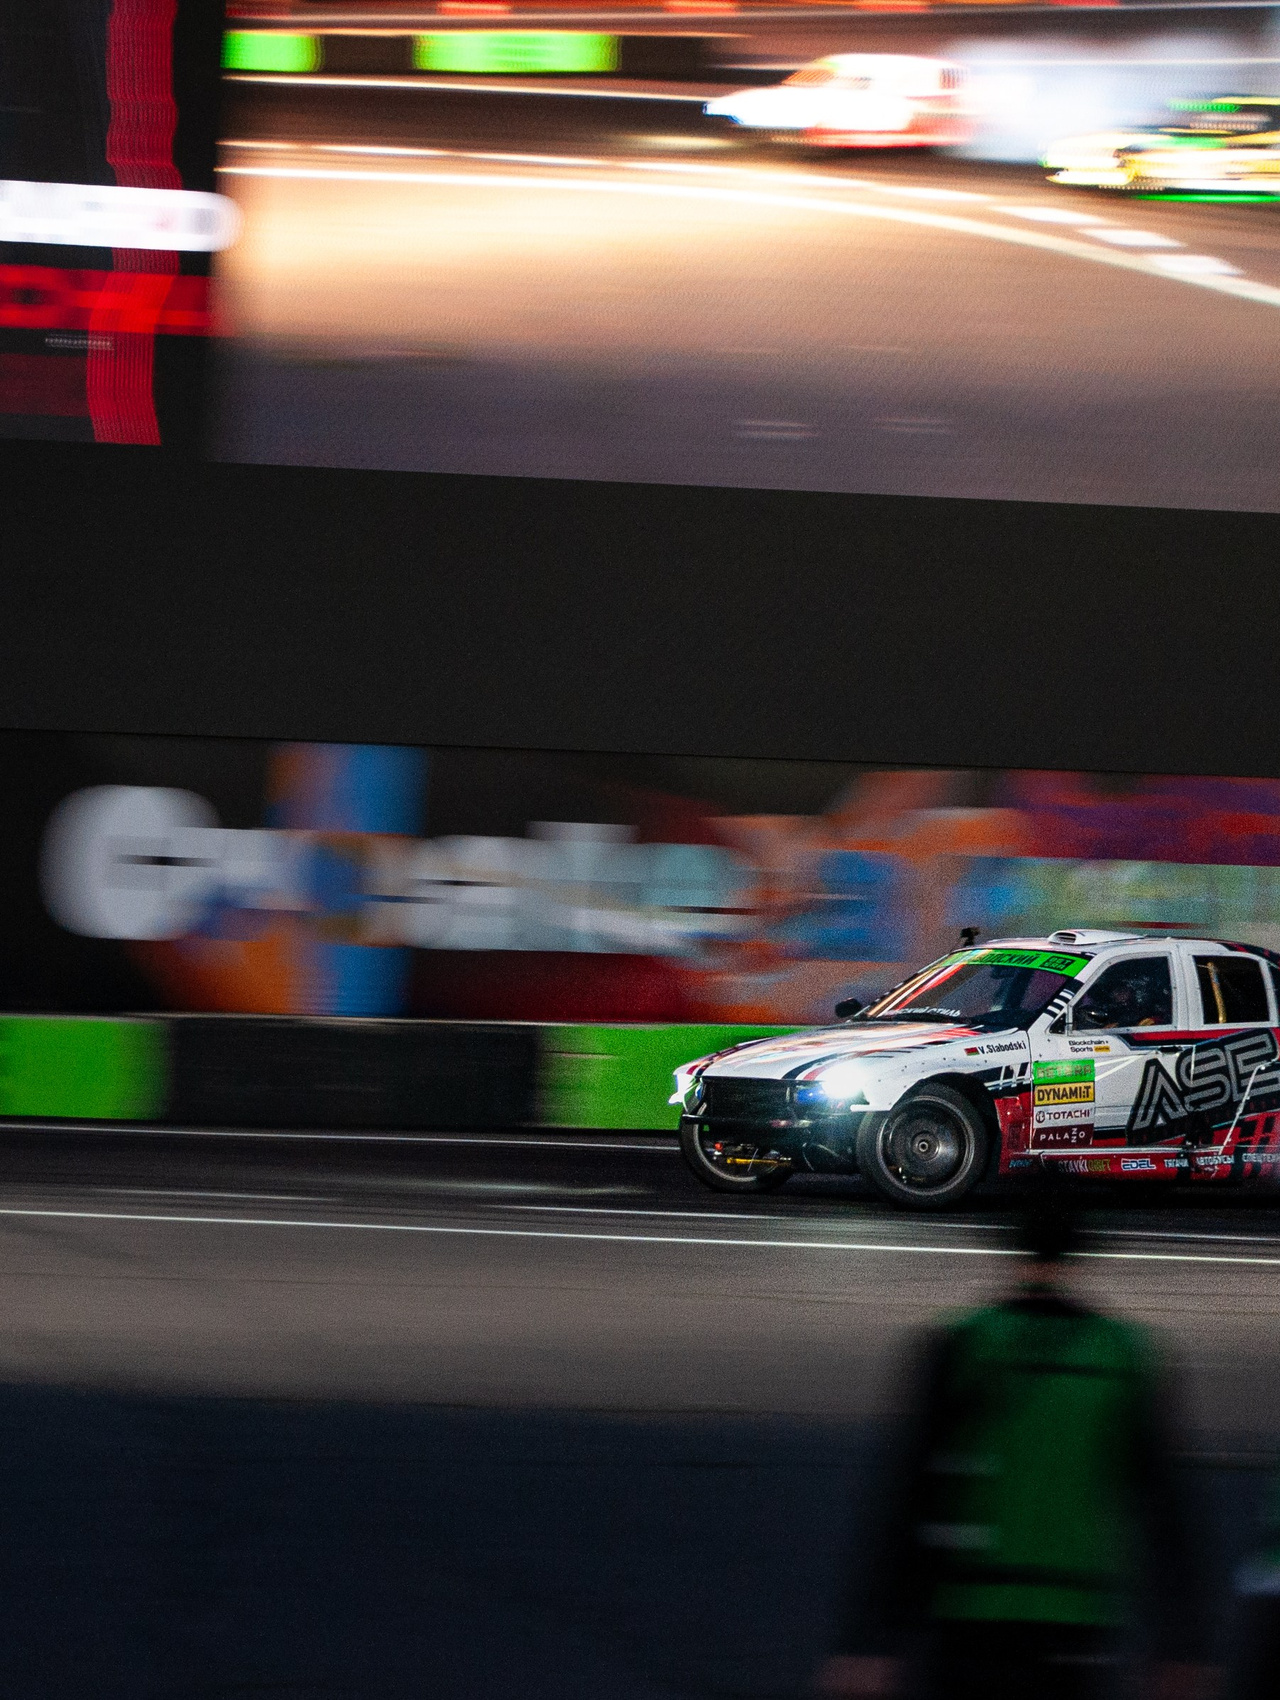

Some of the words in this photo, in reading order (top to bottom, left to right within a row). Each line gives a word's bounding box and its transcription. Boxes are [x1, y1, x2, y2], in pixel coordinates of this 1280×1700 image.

[978, 1040, 1027, 1055] V.Slabodski
[1047, 1109, 1091, 1121] TOTACHI
[1040, 1127, 1086, 1143] PALAZZO
